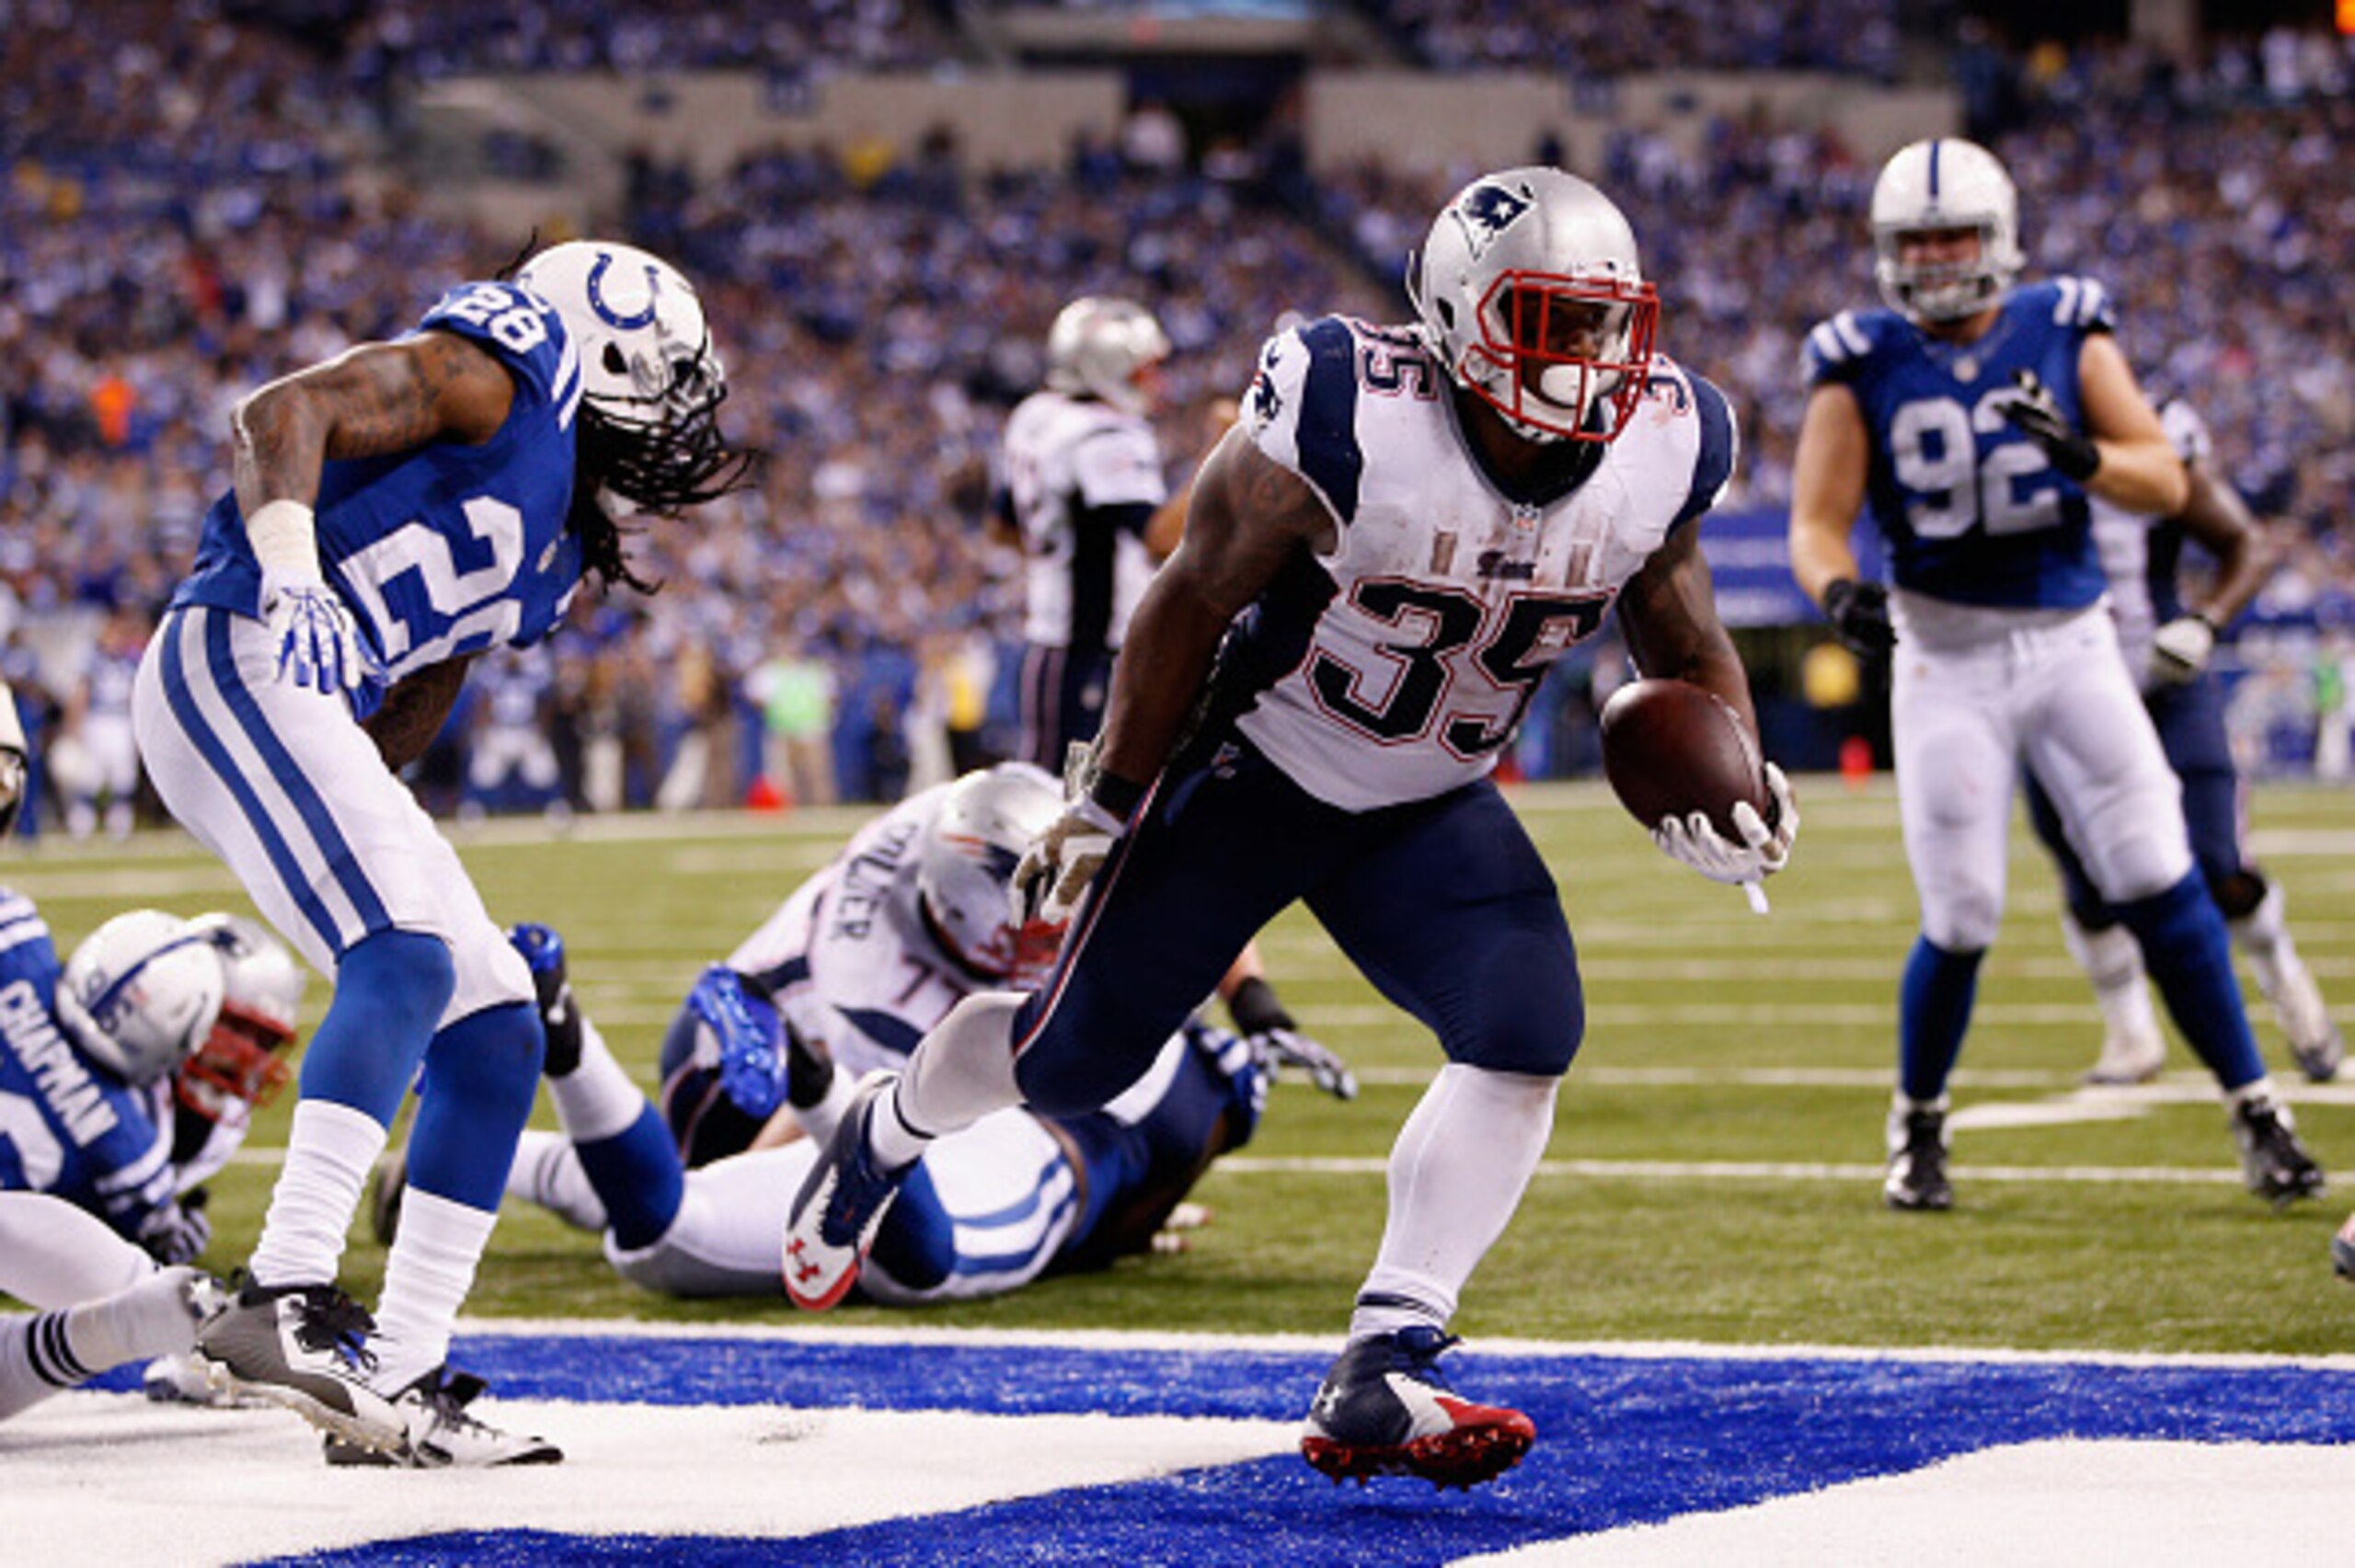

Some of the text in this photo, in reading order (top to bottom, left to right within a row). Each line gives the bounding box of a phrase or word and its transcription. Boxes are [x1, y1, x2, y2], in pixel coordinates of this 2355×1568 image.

[444, 287, 547, 354] 28
[1890, 387, 2063, 539] 92
[1303, 575, 1616, 762] 35
[0, 980, 119, 1148] CHAPMAN
